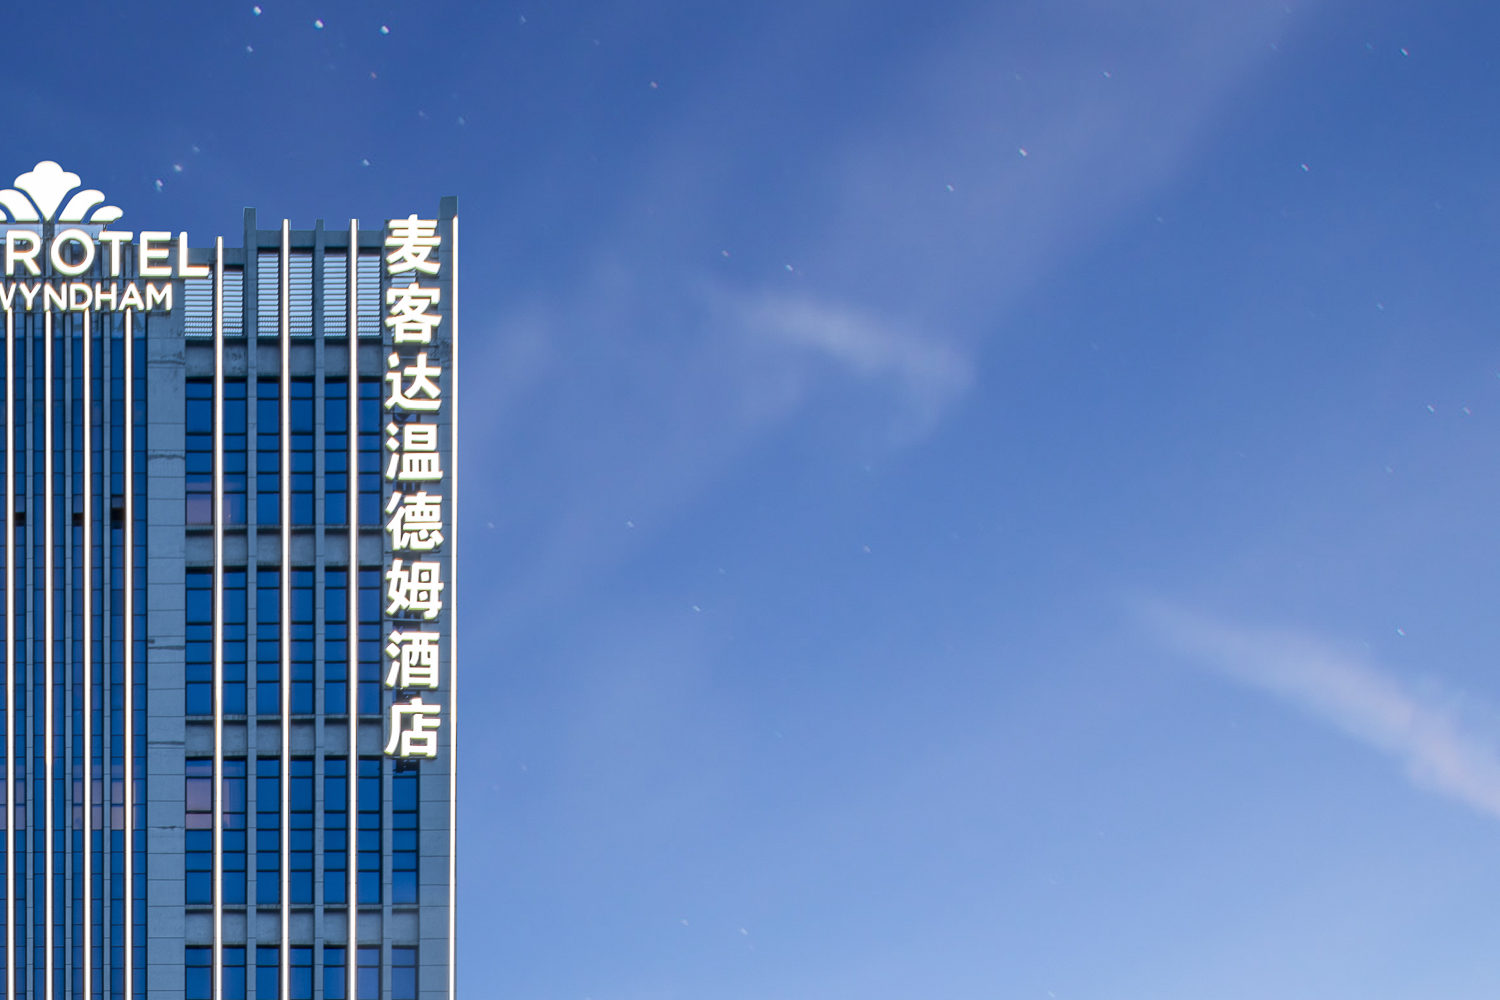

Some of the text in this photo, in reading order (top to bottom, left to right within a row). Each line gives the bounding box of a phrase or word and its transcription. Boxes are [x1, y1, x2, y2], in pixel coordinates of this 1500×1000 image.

[384, 214, 444, 757] 麦客达温德姆酒店
